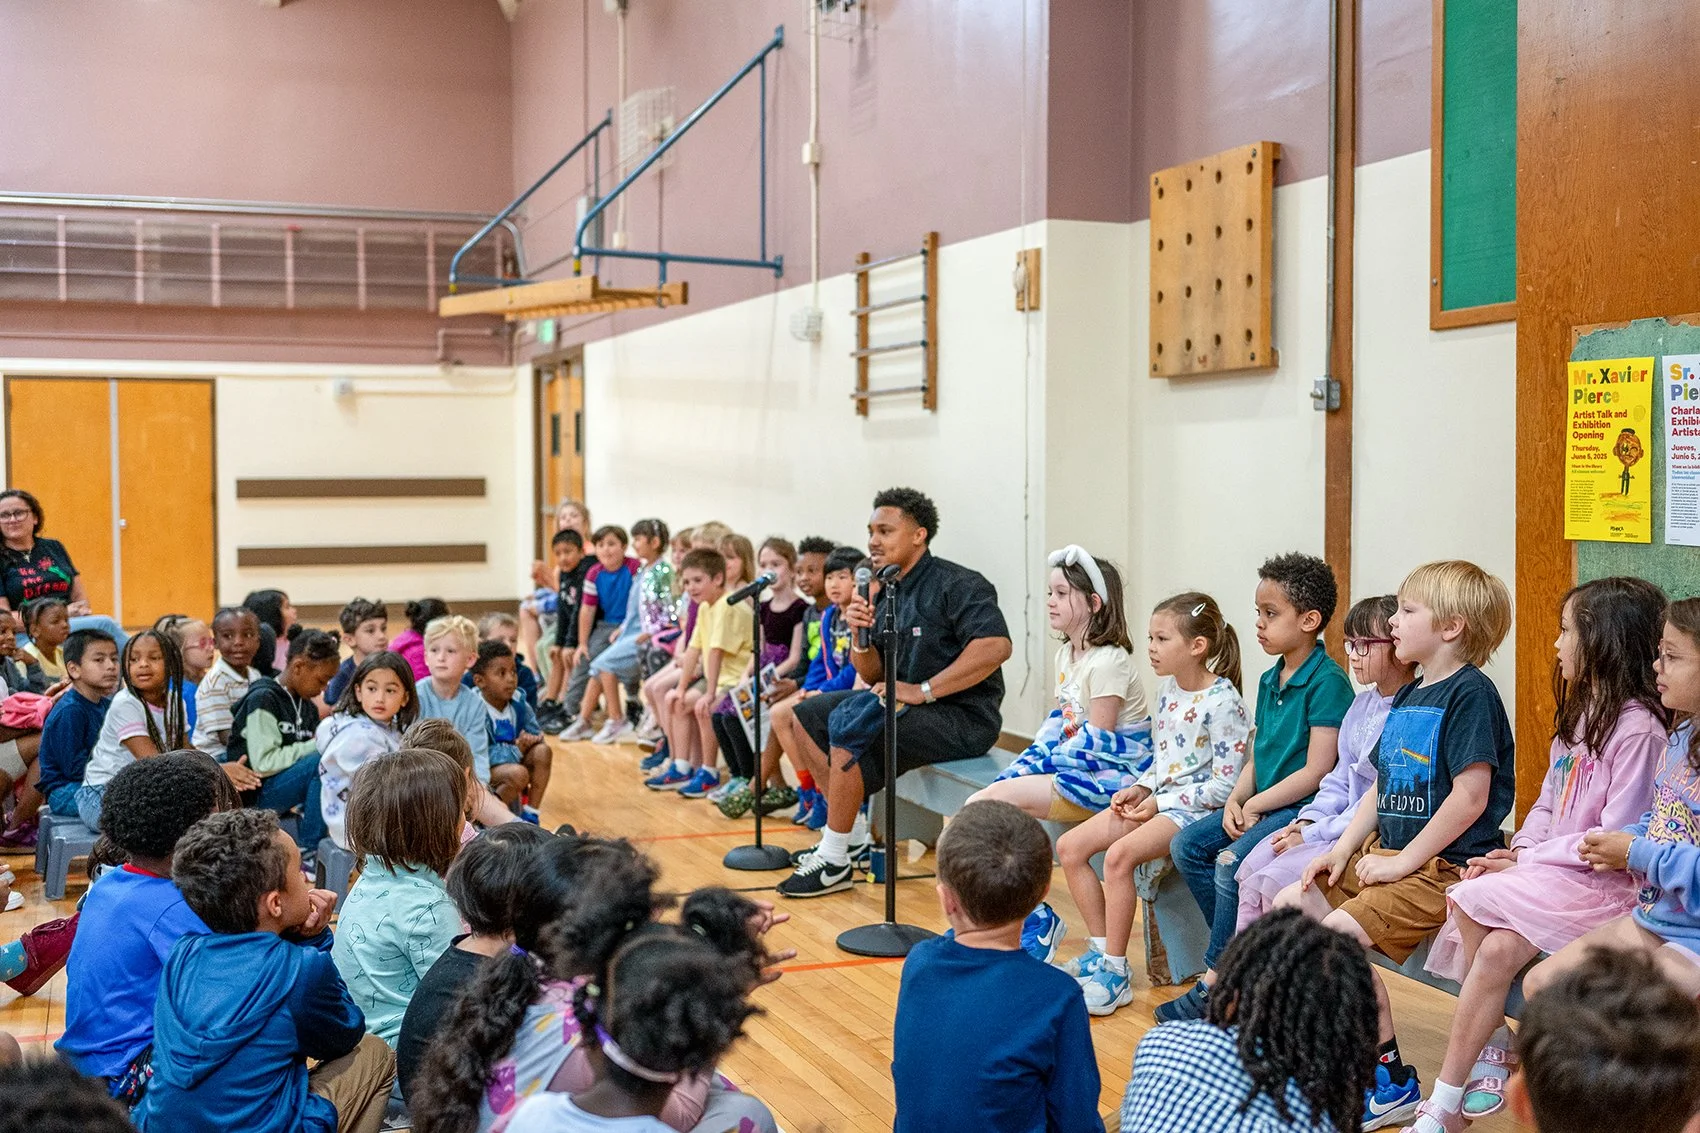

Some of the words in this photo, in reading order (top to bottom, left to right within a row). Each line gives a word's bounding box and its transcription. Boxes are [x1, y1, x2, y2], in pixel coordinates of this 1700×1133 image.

[1573, 369, 1596, 385] Mr.
[1600, 365, 1648, 384] Xavier
[1670, 363, 1695, 381] Sr.
[1573, 388, 1620, 404] Pierce
[1671, 383, 1700, 401] Pie
[1573, 411, 1595, 419] Artist
[1597, 410, 1612, 418] Talk
[1614, 409, 1628, 418] and
[1671, 405, 1700, 415] Charla
[1573, 420, 1611, 429] Exhibition
[1572, 430, 1604, 440] Opening
[1390, 794, 1425, 813] FLOYD
